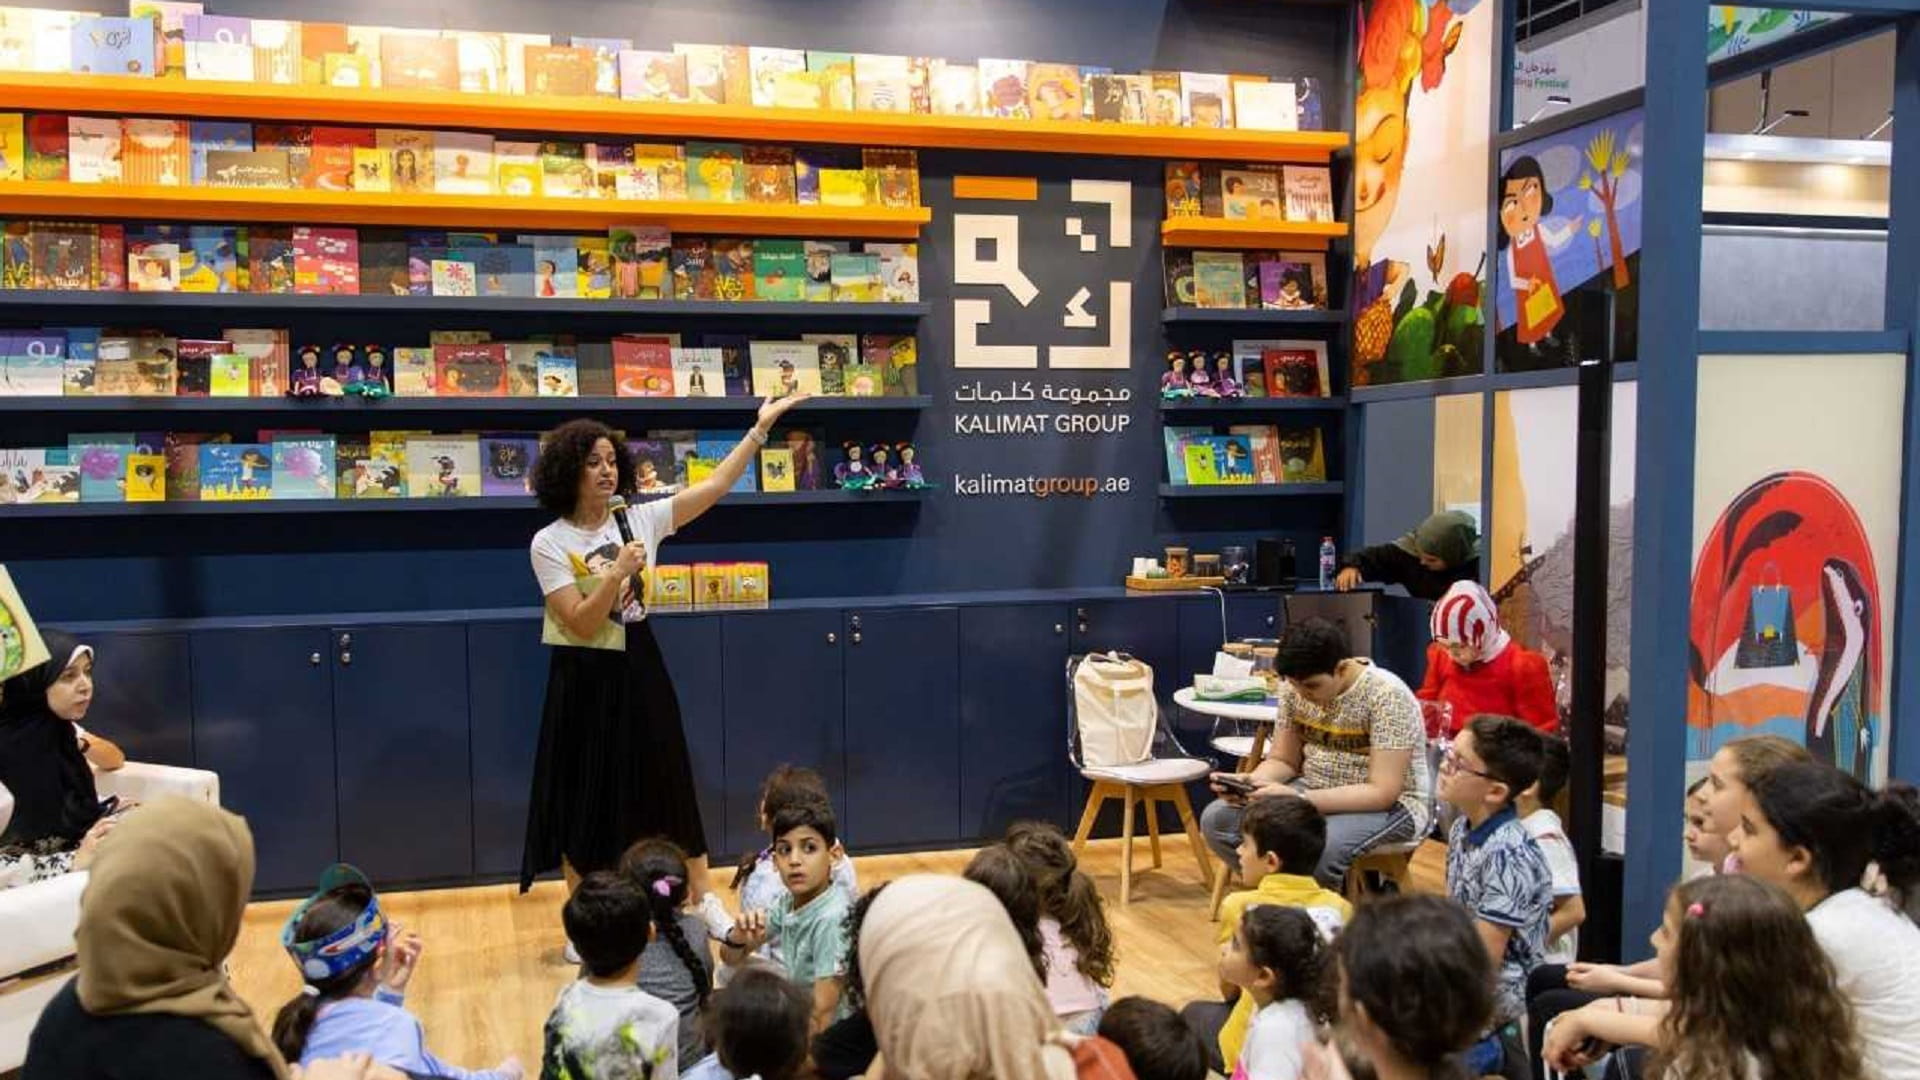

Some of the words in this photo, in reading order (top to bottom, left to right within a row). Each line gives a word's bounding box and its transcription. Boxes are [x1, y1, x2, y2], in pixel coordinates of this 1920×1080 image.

[1535, 79, 1568, 88] Festival
[955, 381, 1035, 402] كلمات
[1041, 384, 1131, 407] مجموعة
[955, 414, 1049, 433] KALIMAT
[1055, 414, 1130, 433] GROUP
[955, 474, 1130, 497] kalimatgroup.ae
